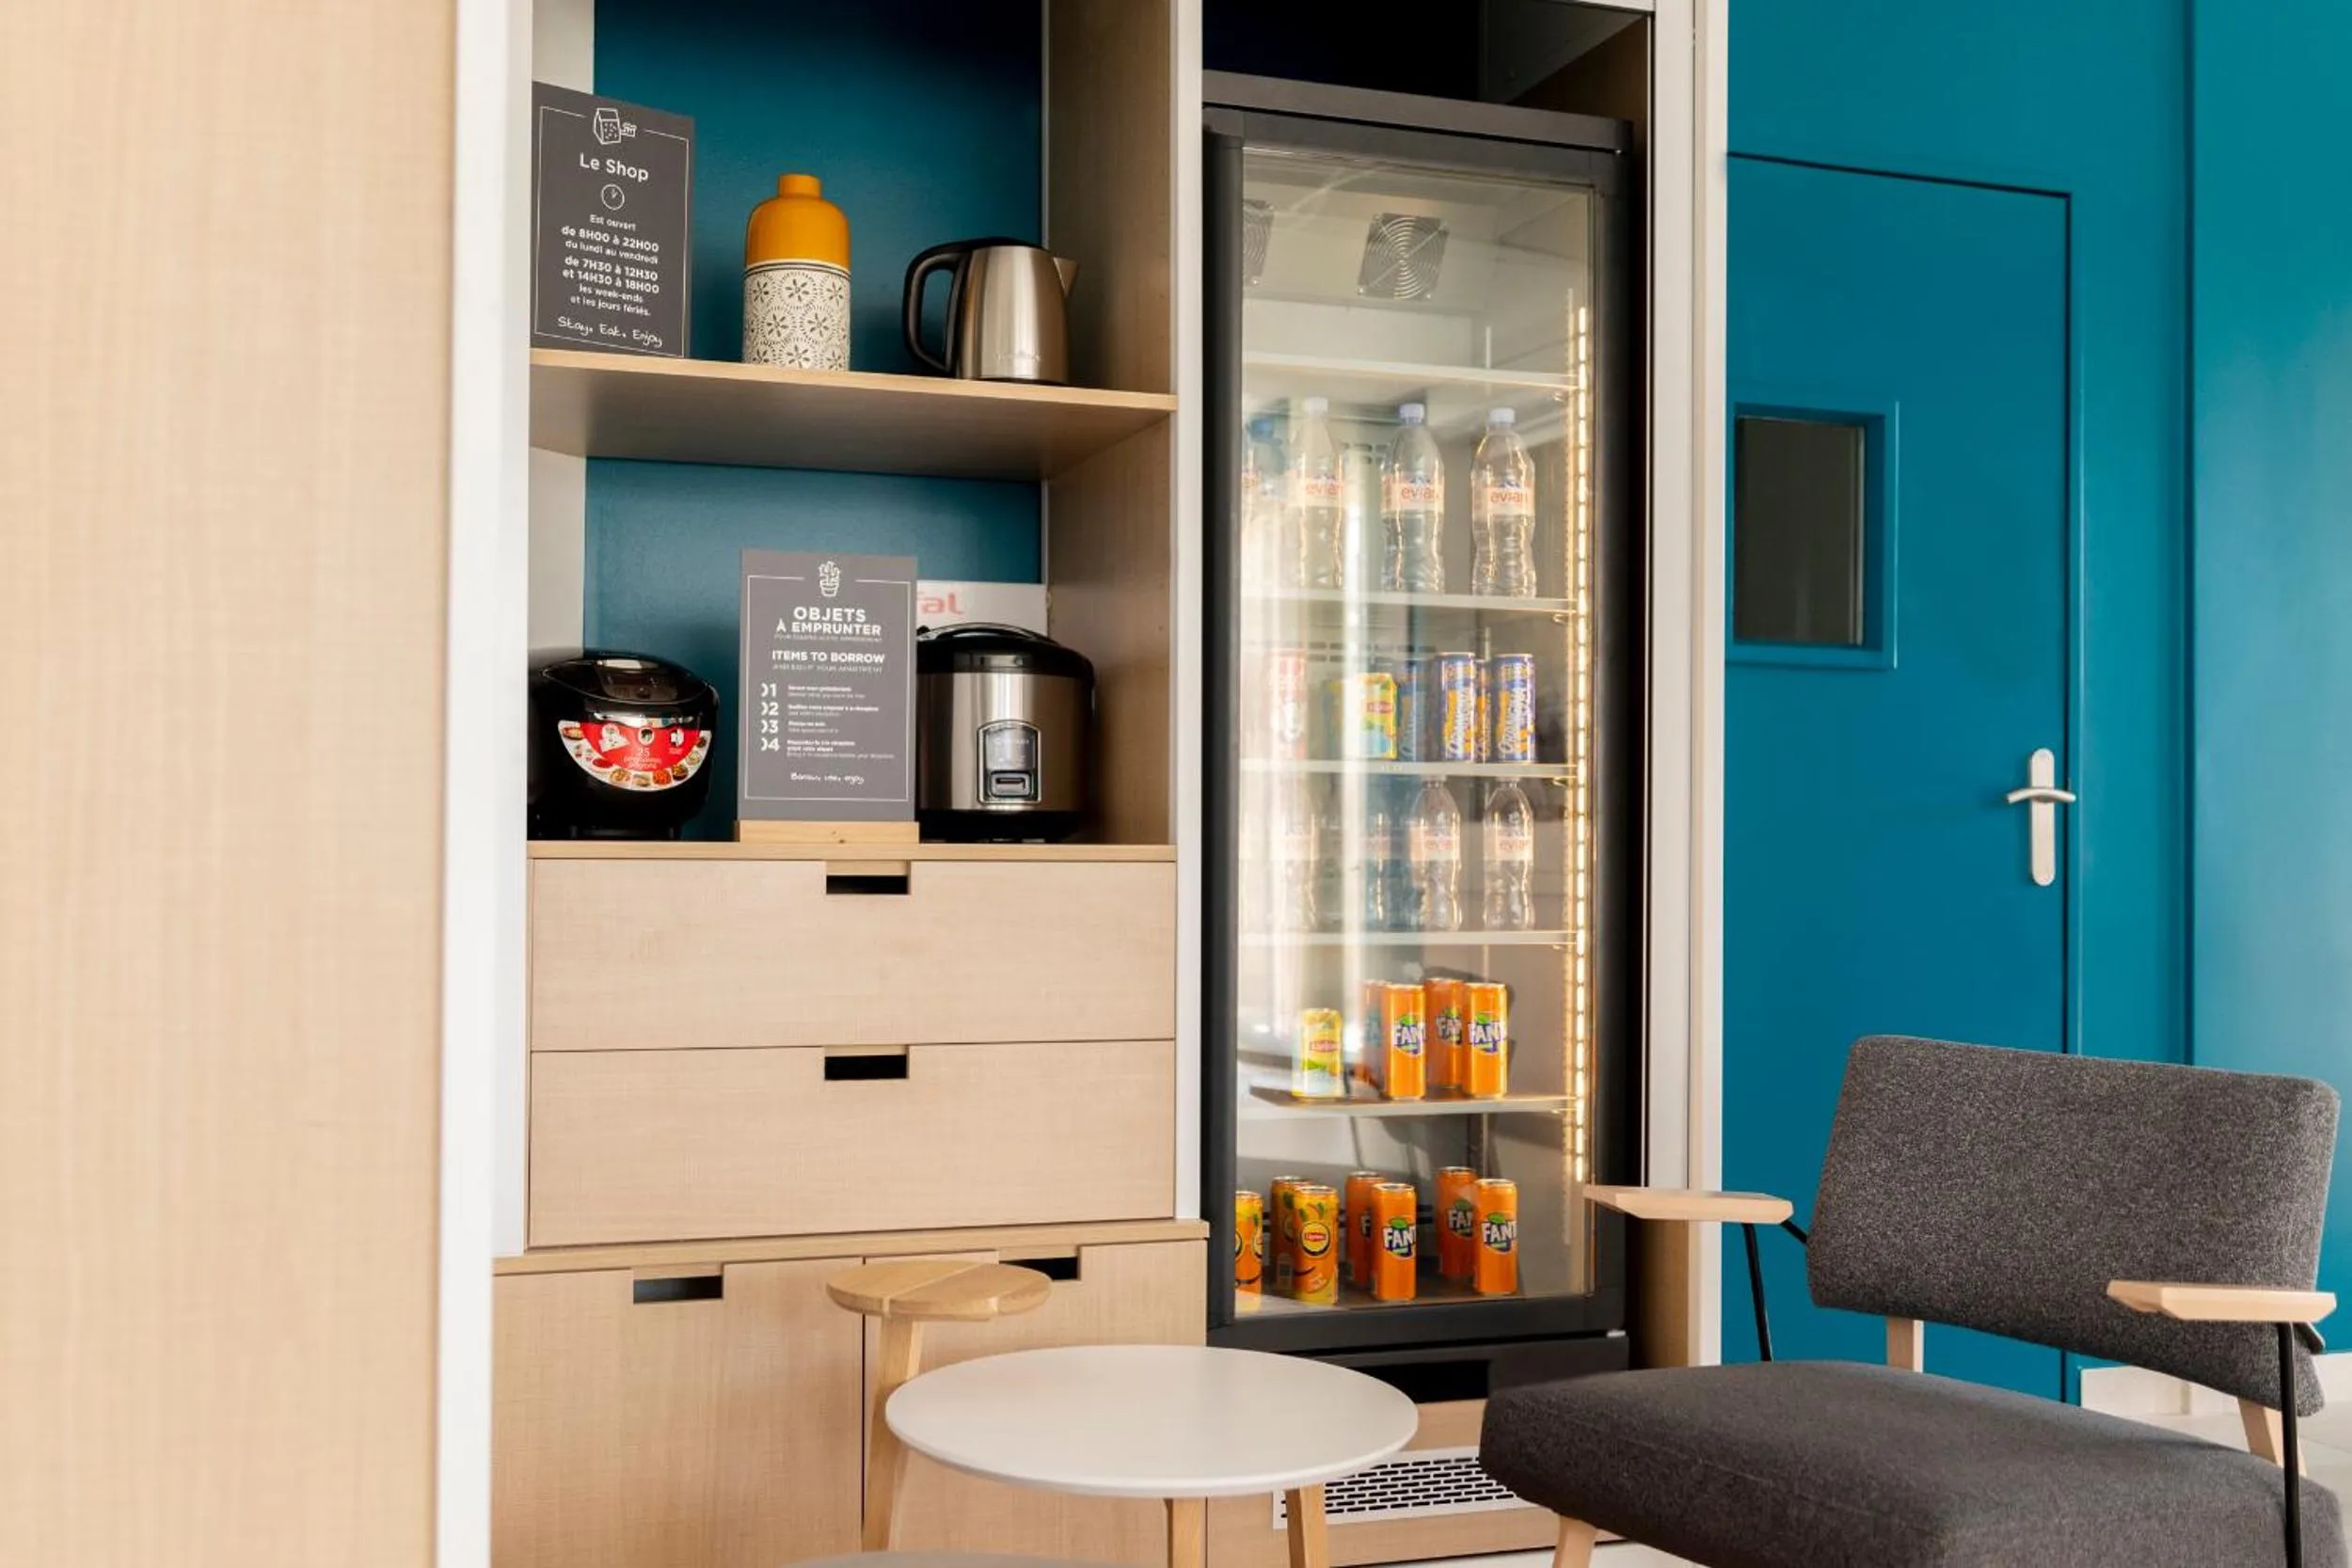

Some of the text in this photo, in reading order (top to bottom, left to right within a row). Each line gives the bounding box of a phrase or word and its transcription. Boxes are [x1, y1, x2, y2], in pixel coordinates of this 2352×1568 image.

[580, 151, 649, 182] Le Shop
[590, 214, 637, 231] Est ouvert
[561, 225, 577, 236] de
[579, 228, 611, 243] 8H00
[622, 237, 660, 253] 22H00
[564, 239, 658, 265] du lundi au vendredi
[564, 255, 580, 267] de
[582, 258, 612, 273] 7H30
[625, 266, 659, 282] 12H30
[562, 268, 575, 279] et
[577, 270, 612, 286] 14H30
[625, 279, 660, 294] 18H00
[570, 295, 580, 305] et
[582, 296, 596, 308] les
[596, 299, 621, 311] jours
[579, 283, 644, 304] les week-ends
[557, 315, 663, 349] Stay. Eat. Enjoy
[793, 607, 866, 622] OBJETS
[791, 622, 882, 636] EMPRUNTER
[771, 650, 885, 664] ITEMS TO BORROW
